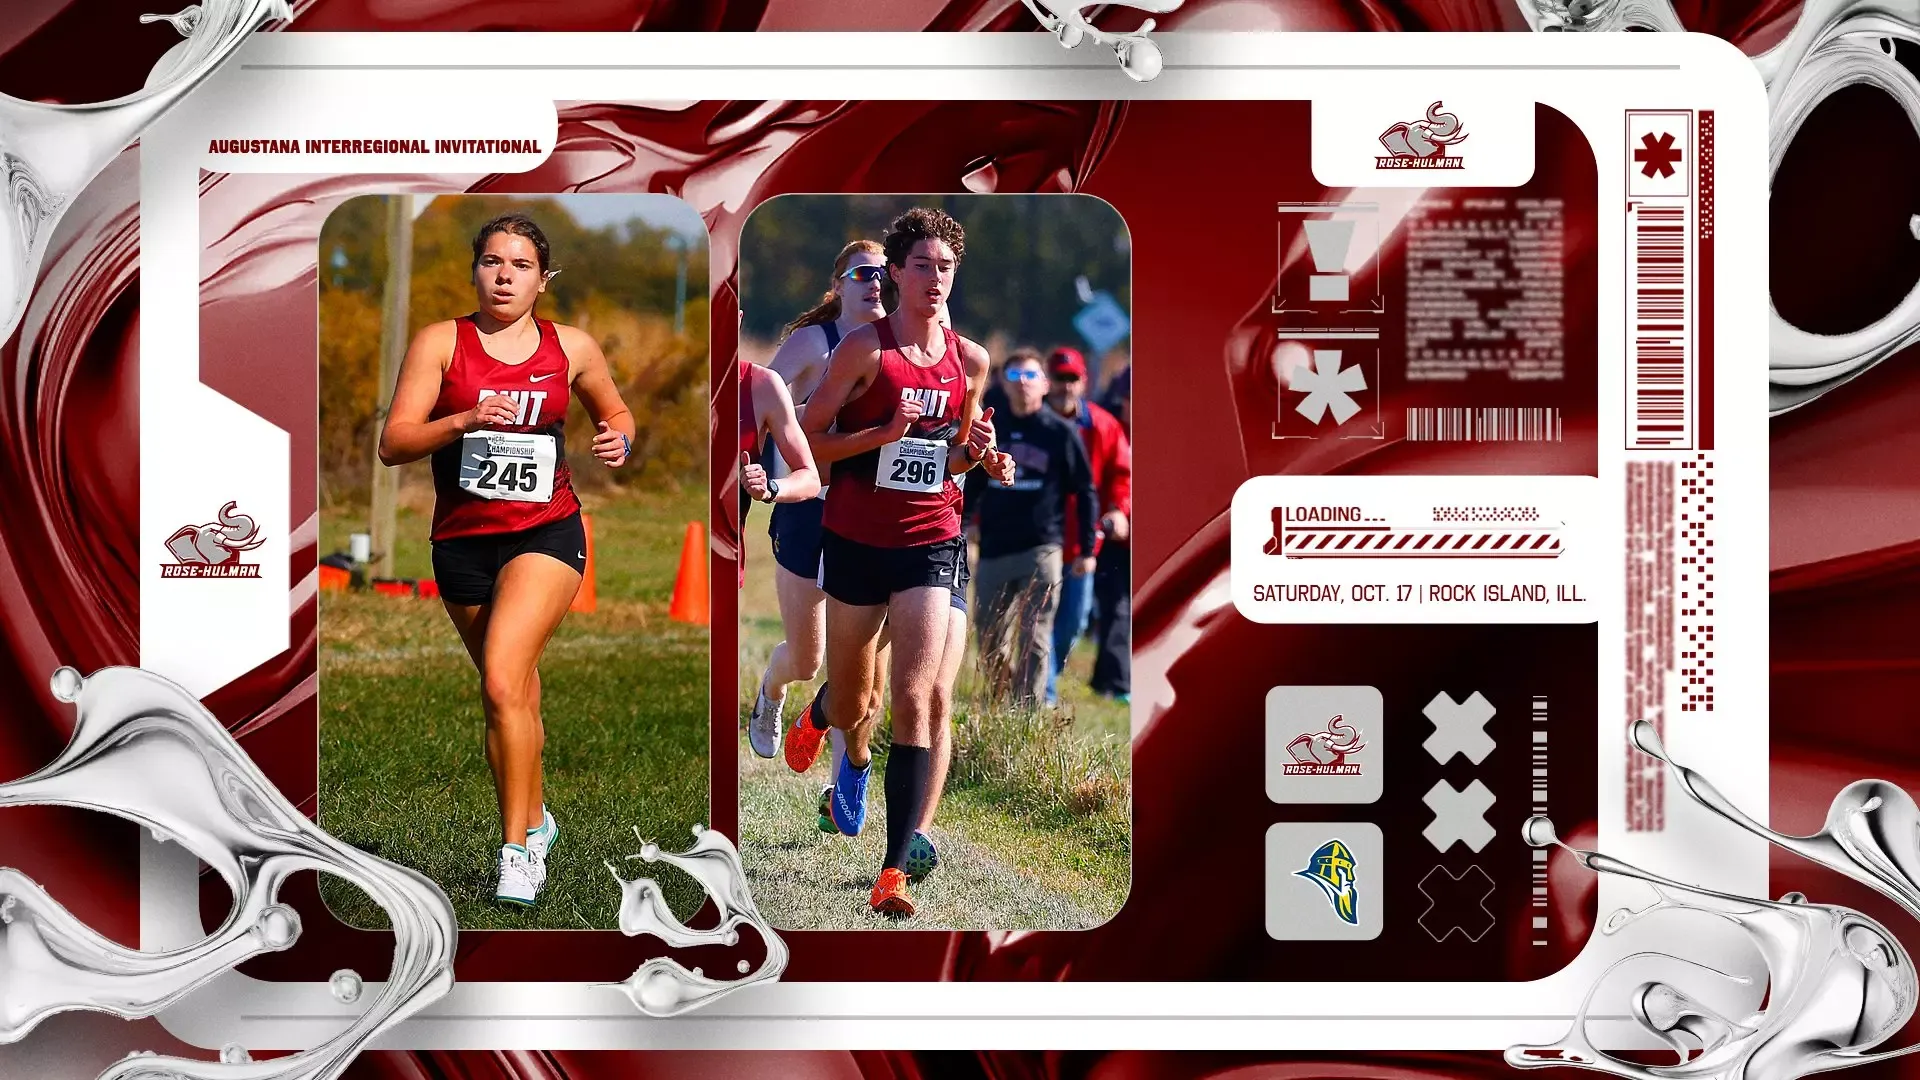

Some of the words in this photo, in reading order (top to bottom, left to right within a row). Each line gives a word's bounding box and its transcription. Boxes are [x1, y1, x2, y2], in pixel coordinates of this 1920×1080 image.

[487, 443, 535, 456] CHAMPIONSHIP
[477, 460, 537, 492] 245
[890, 459, 937, 485] 296
